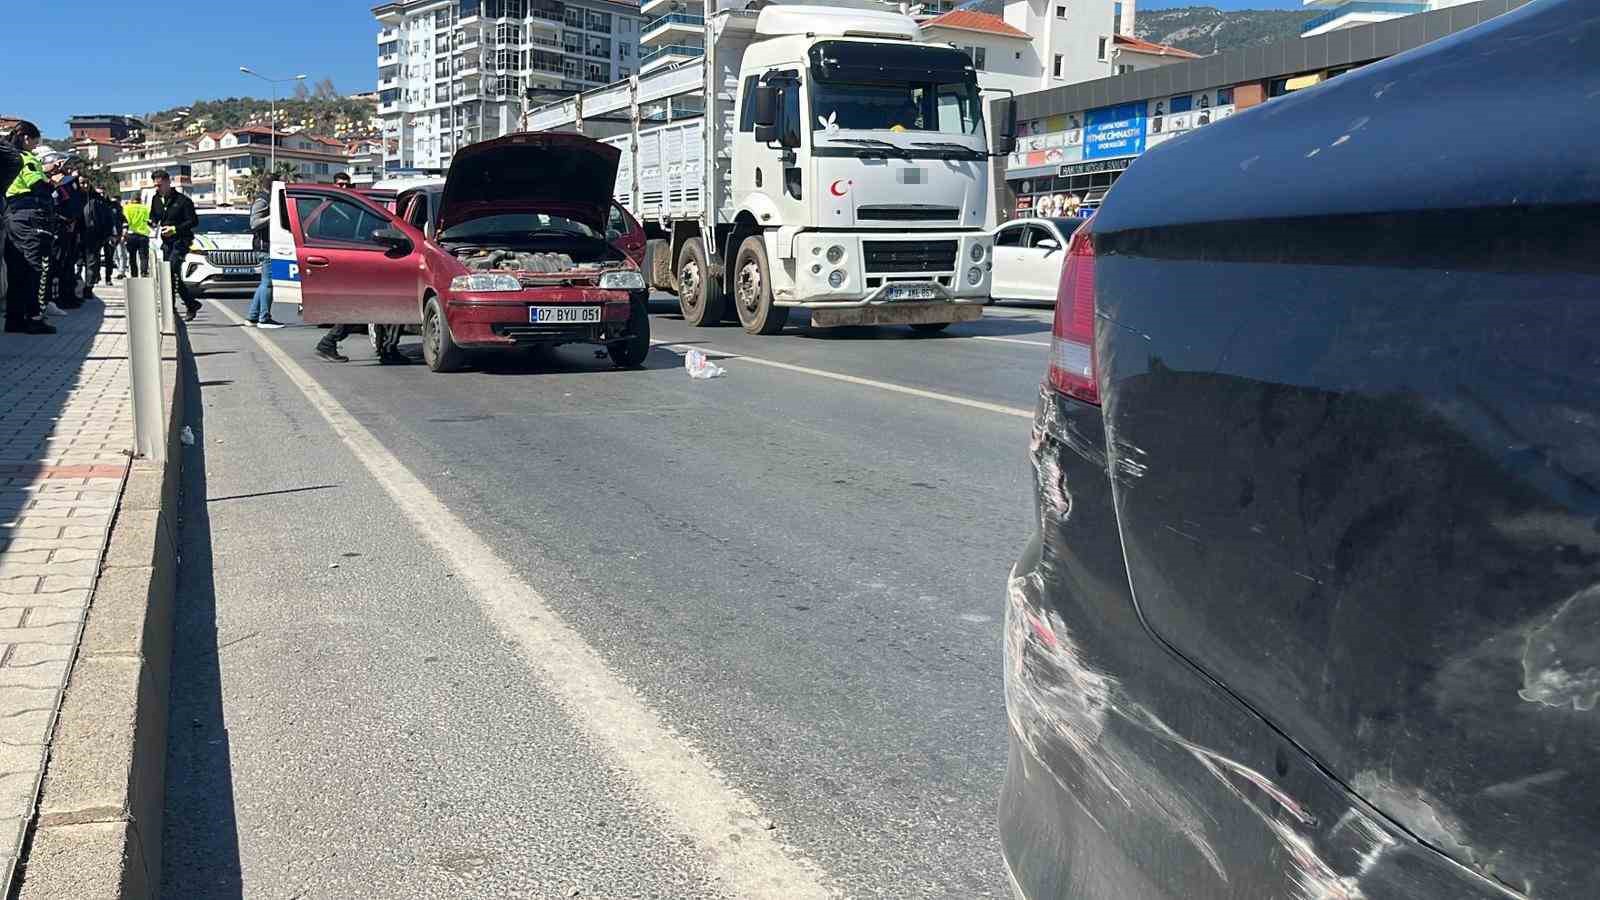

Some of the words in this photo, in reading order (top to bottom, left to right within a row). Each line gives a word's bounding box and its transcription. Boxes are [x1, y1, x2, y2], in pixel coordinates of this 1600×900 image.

[538, 309, 551, 321] 07
[557, 309, 577, 321] BYU
[583, 309, 599, 321] 051
